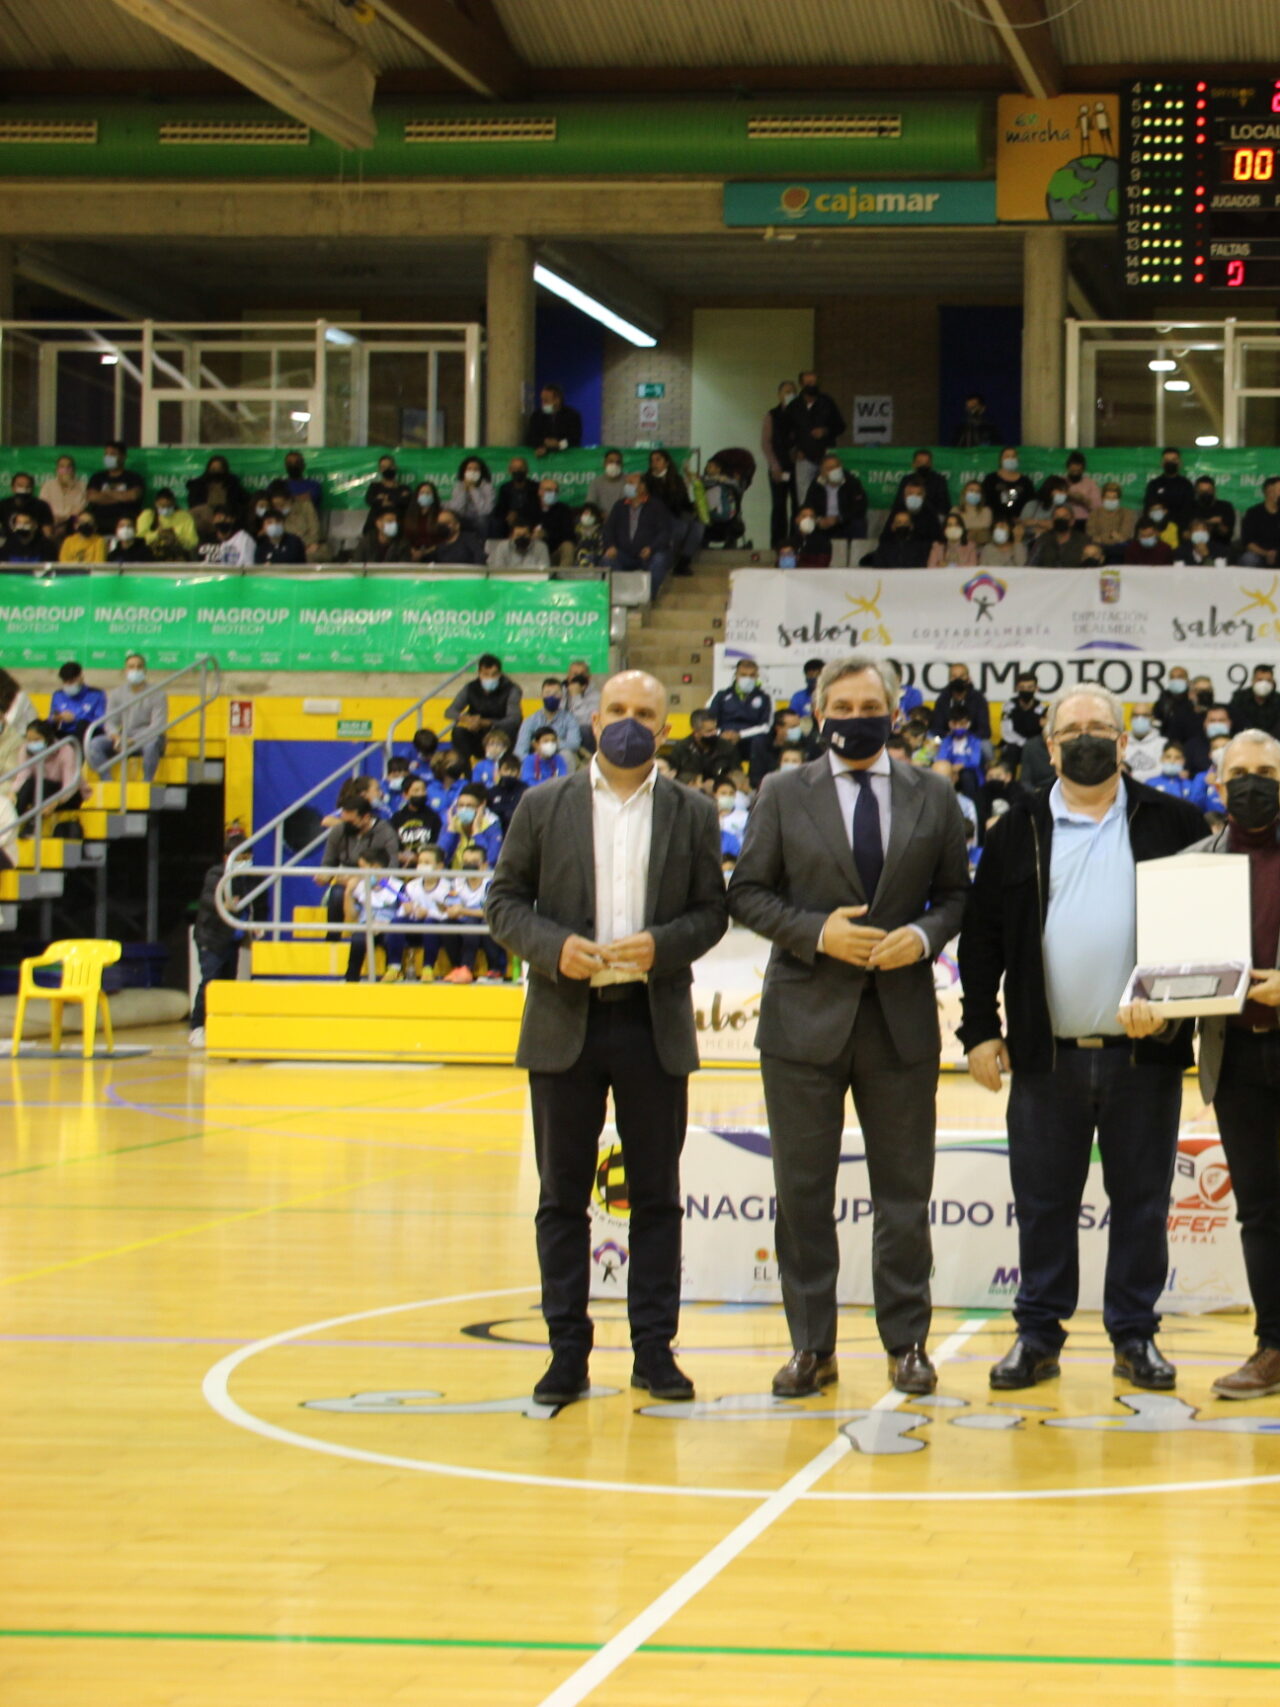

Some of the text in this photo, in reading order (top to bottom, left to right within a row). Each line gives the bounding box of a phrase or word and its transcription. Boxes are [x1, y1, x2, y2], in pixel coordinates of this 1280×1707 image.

[1232, 148, 1275, 181] 00
[815, 187, 940, 220] cajamar
[1210, 194, 1261, 208] JUGADOR
[1210, 243, 1252, 257] FALTAS
[0, 606, 85, 622] NAGROUP
[94, 606, 188, 623] INAGROUP
[197, 607, 290, 624] INAGROUP
[299, 608, 393, 625] INAGROUP
[402, 608, 496, 626] INAGROUP
[505, 610, 600, 627] INAGROUP
[778, 611, 893, 648] sabores
[980, 659, 1168, 695] MOTOR
[1170, 1235, 1217, 1245] UTSAL
